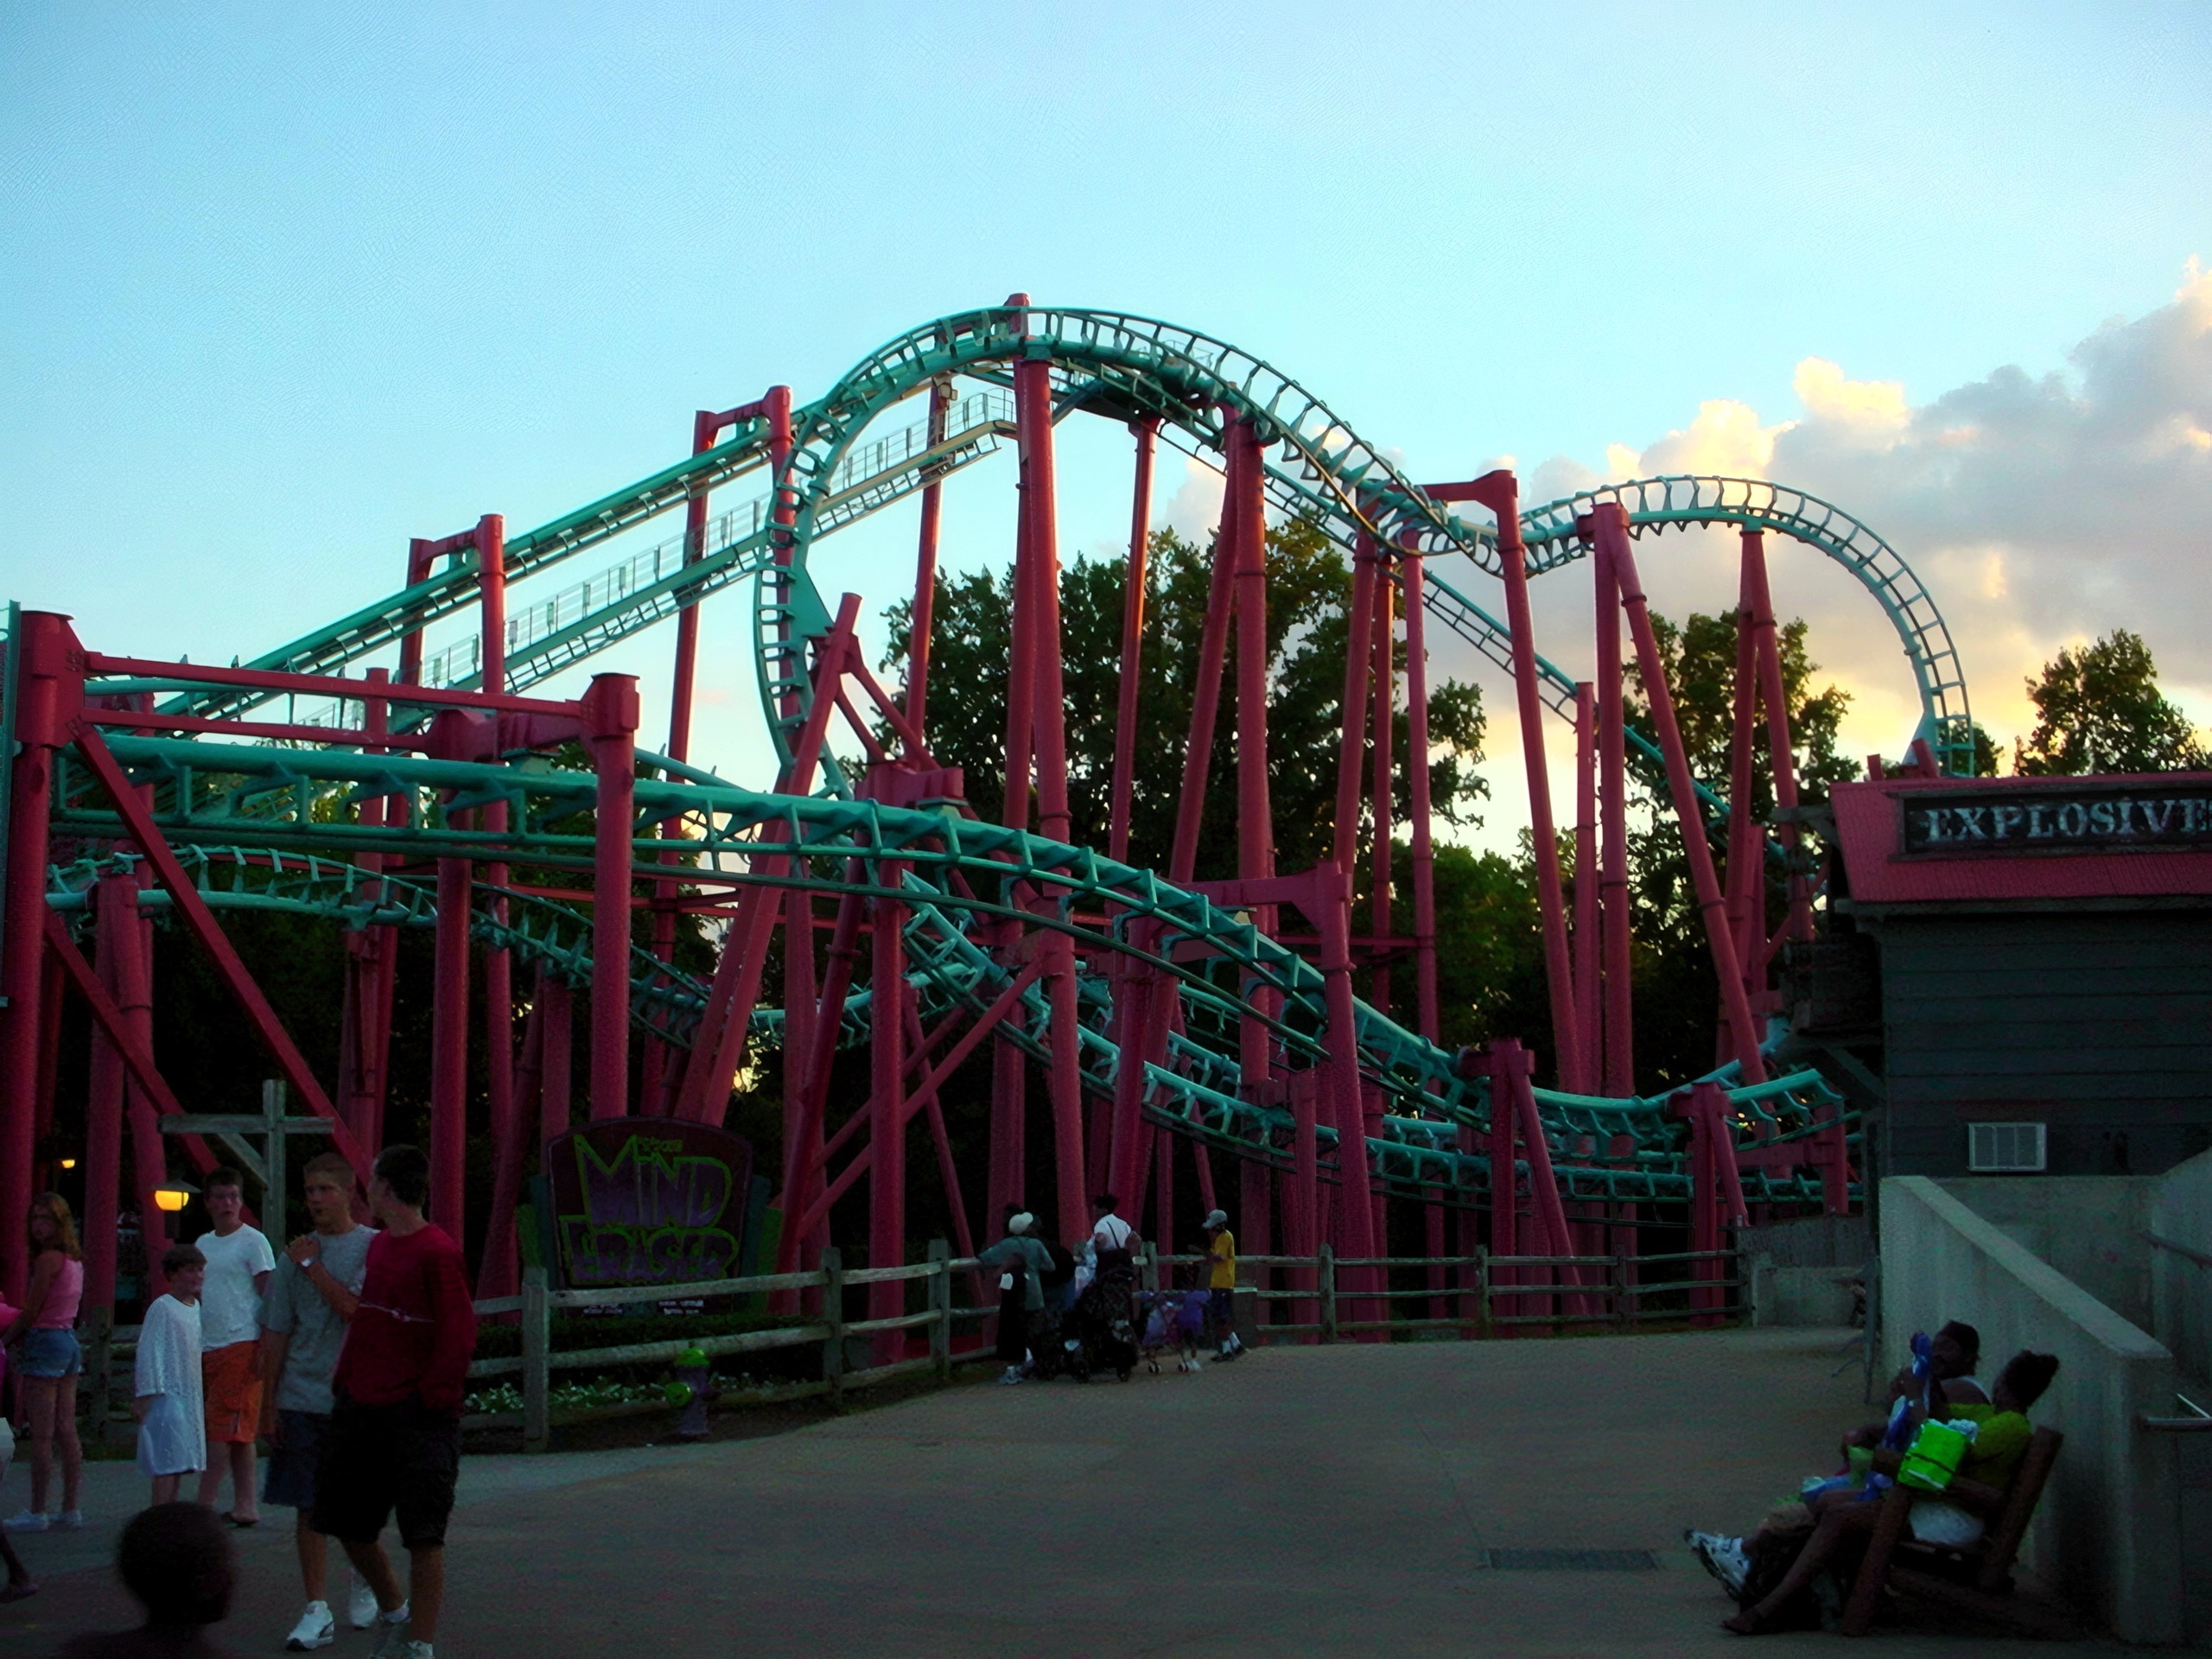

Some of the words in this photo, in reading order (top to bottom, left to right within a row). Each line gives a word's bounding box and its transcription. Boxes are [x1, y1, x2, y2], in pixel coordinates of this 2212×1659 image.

[1925, 798, 2212, 843] EXPLOSIVE
[573, 1134, 734, 1230] MIND
[557, 1214, 741, 1287] ERASER
